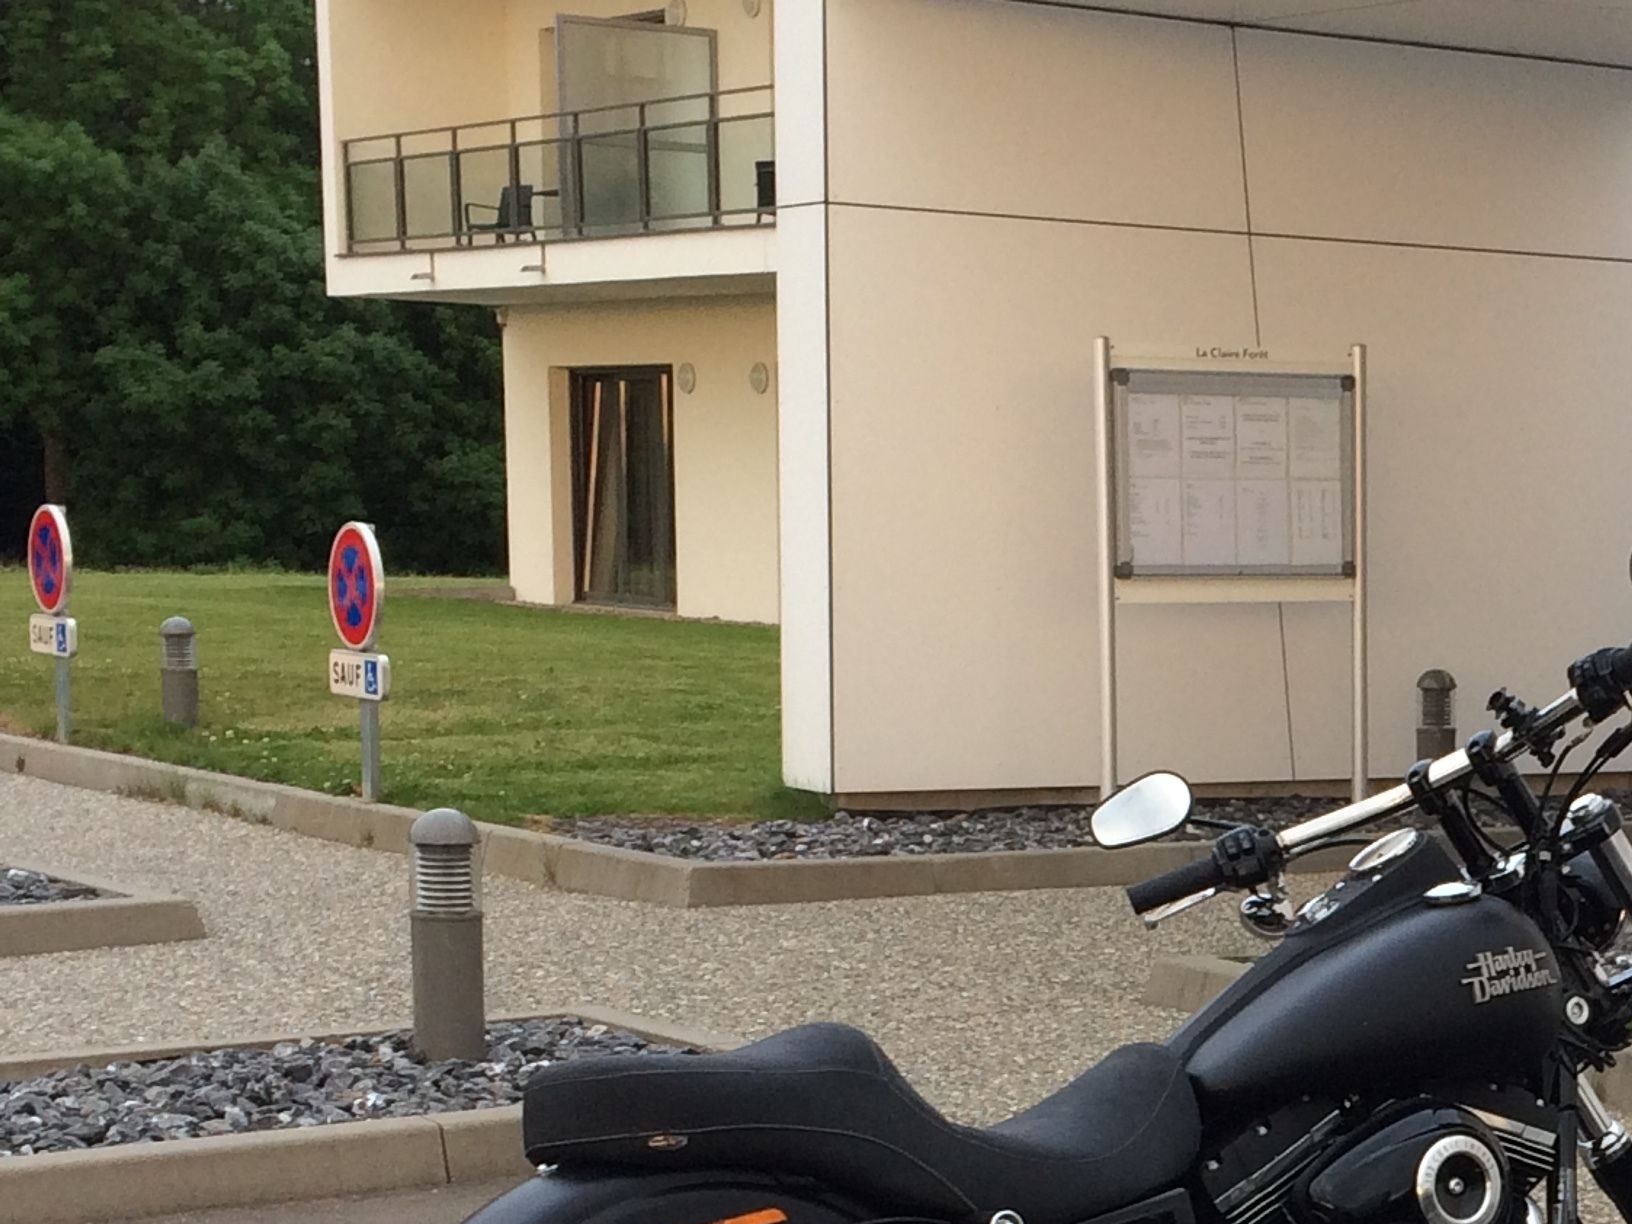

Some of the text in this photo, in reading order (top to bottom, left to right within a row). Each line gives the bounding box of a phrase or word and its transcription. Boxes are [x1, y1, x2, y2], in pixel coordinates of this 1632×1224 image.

[1195, 347, 1208, 358] La
[333, 661, 362, 687] SAUF
[1460, 968, 1558, 1004] Davidson
